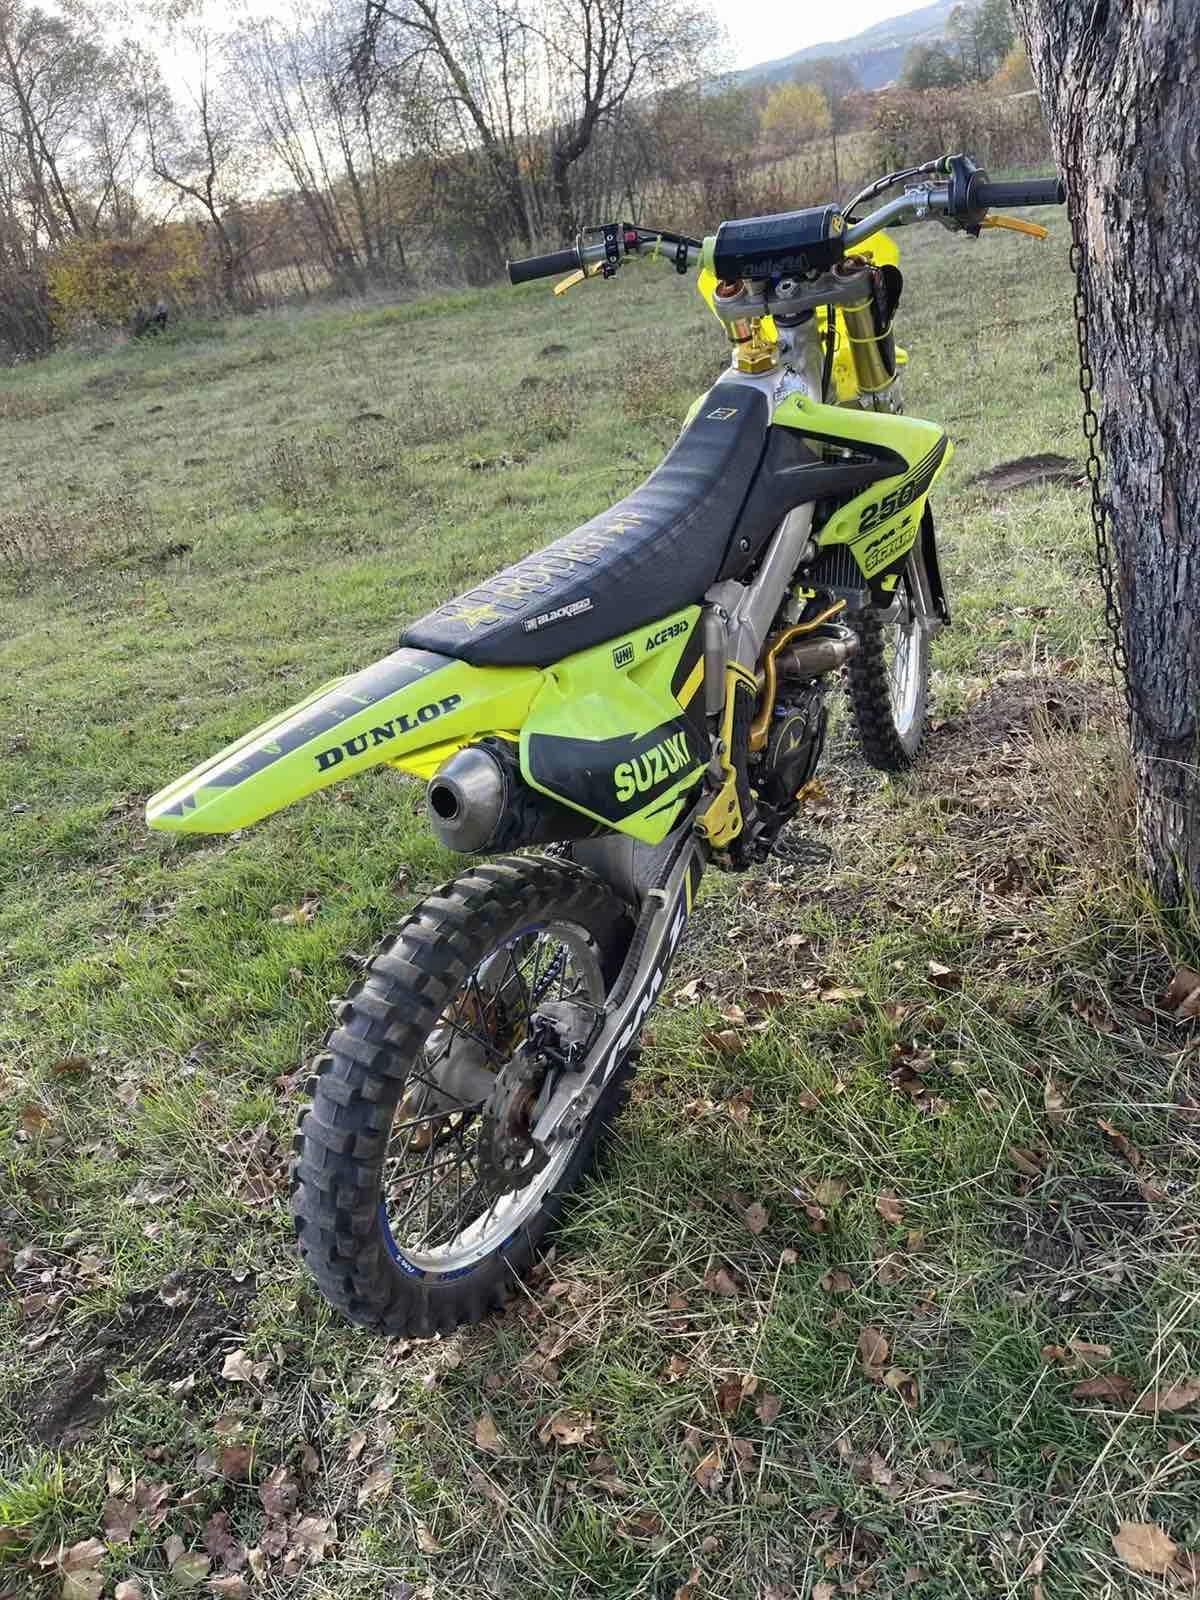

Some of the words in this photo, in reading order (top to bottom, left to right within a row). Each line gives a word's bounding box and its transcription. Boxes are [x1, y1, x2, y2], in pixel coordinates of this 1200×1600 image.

[859, 480, 917, 533] 250
[615, 646, 633, 665] UNI
[645, 620, 689, 651] ACERBIS
[312, 693, 463, 773] DUNLOP
[614, 730, 693, 802] SUZUKI
